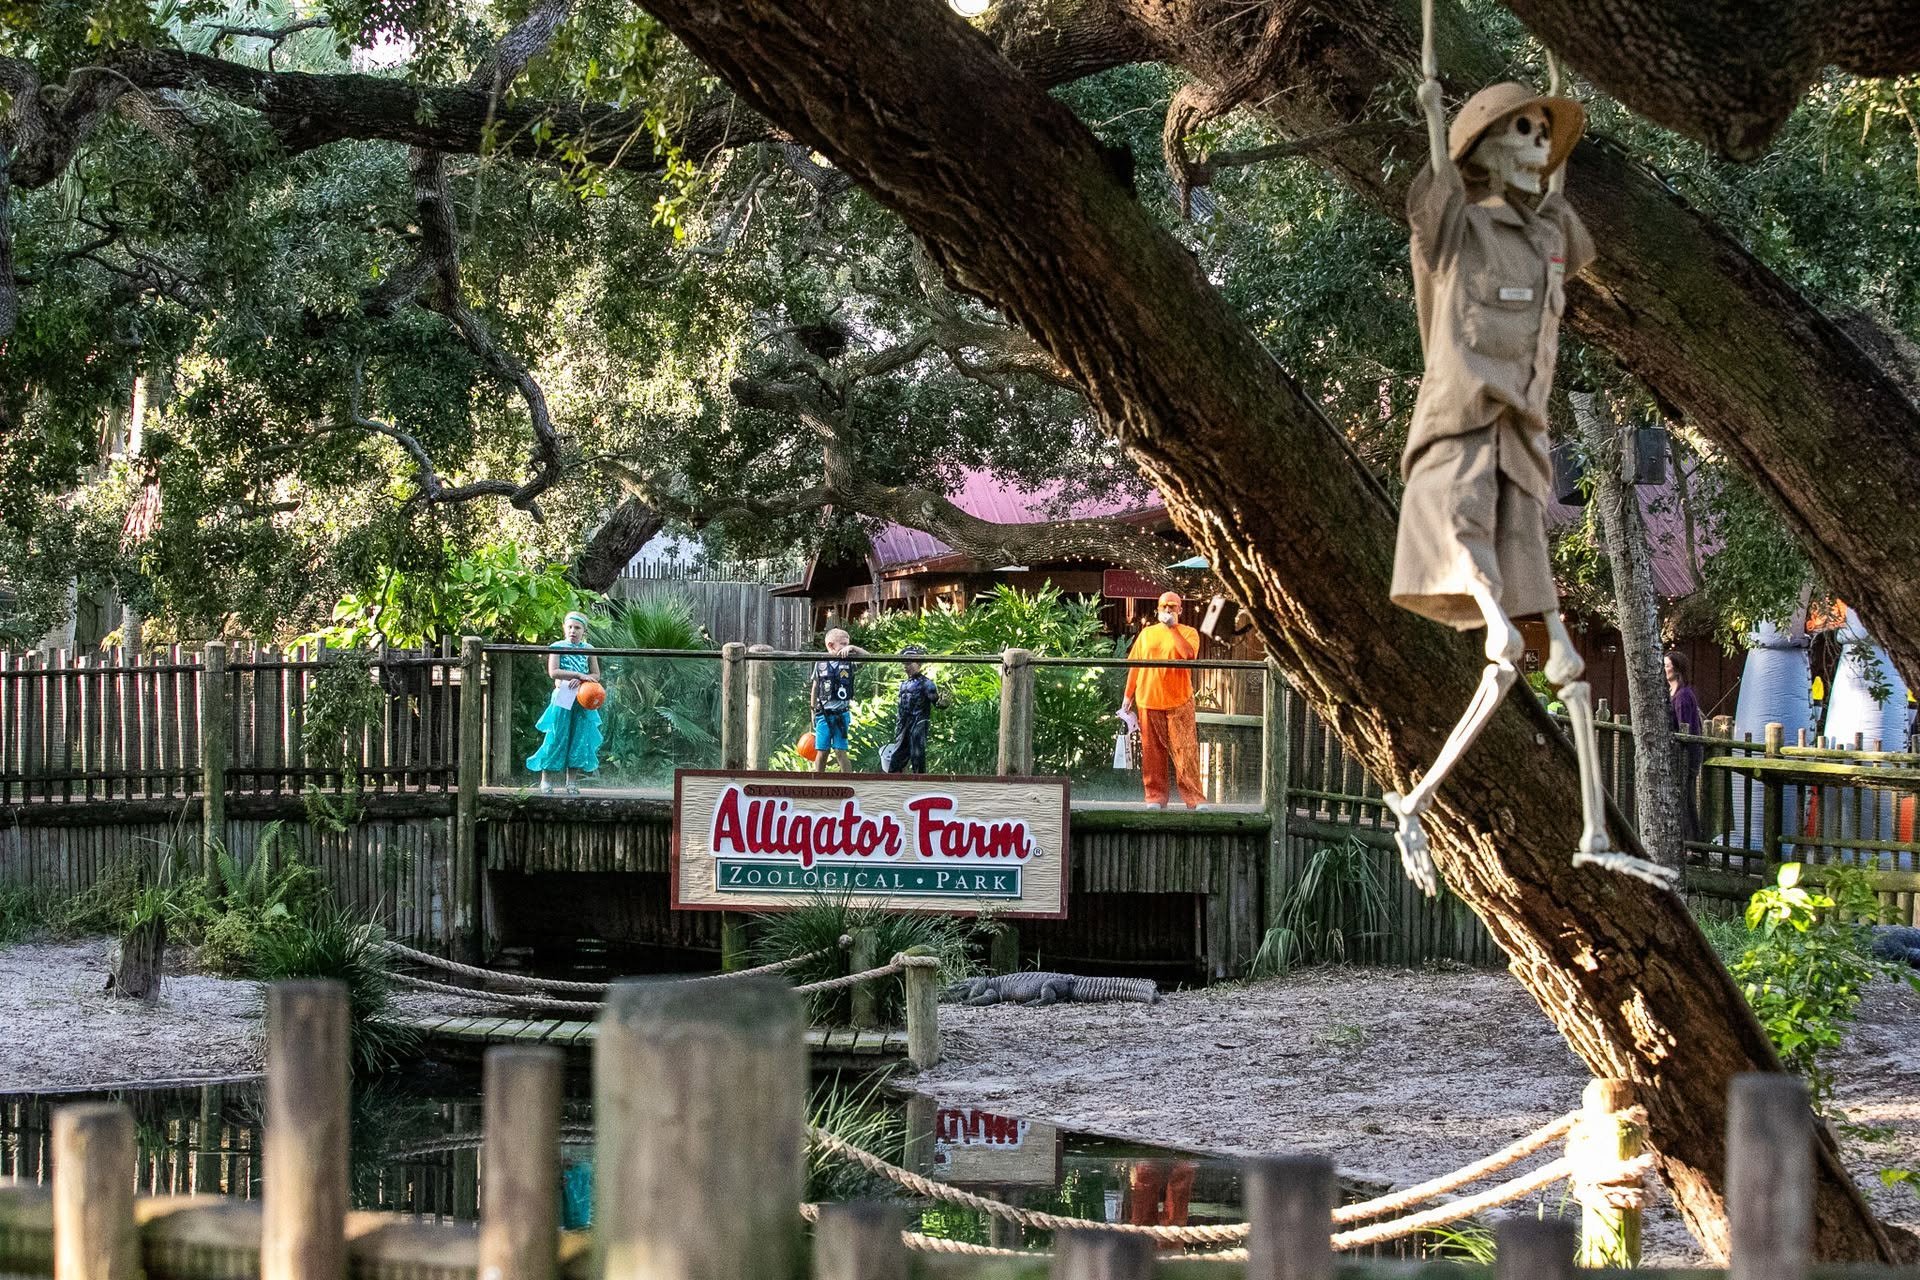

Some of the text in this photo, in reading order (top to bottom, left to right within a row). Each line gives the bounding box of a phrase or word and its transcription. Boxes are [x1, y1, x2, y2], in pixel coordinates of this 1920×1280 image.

[713, 787, 1030, 867] Alligator Farm
[728, 866, 1007, 890] ZOOLOGICAL PARK
